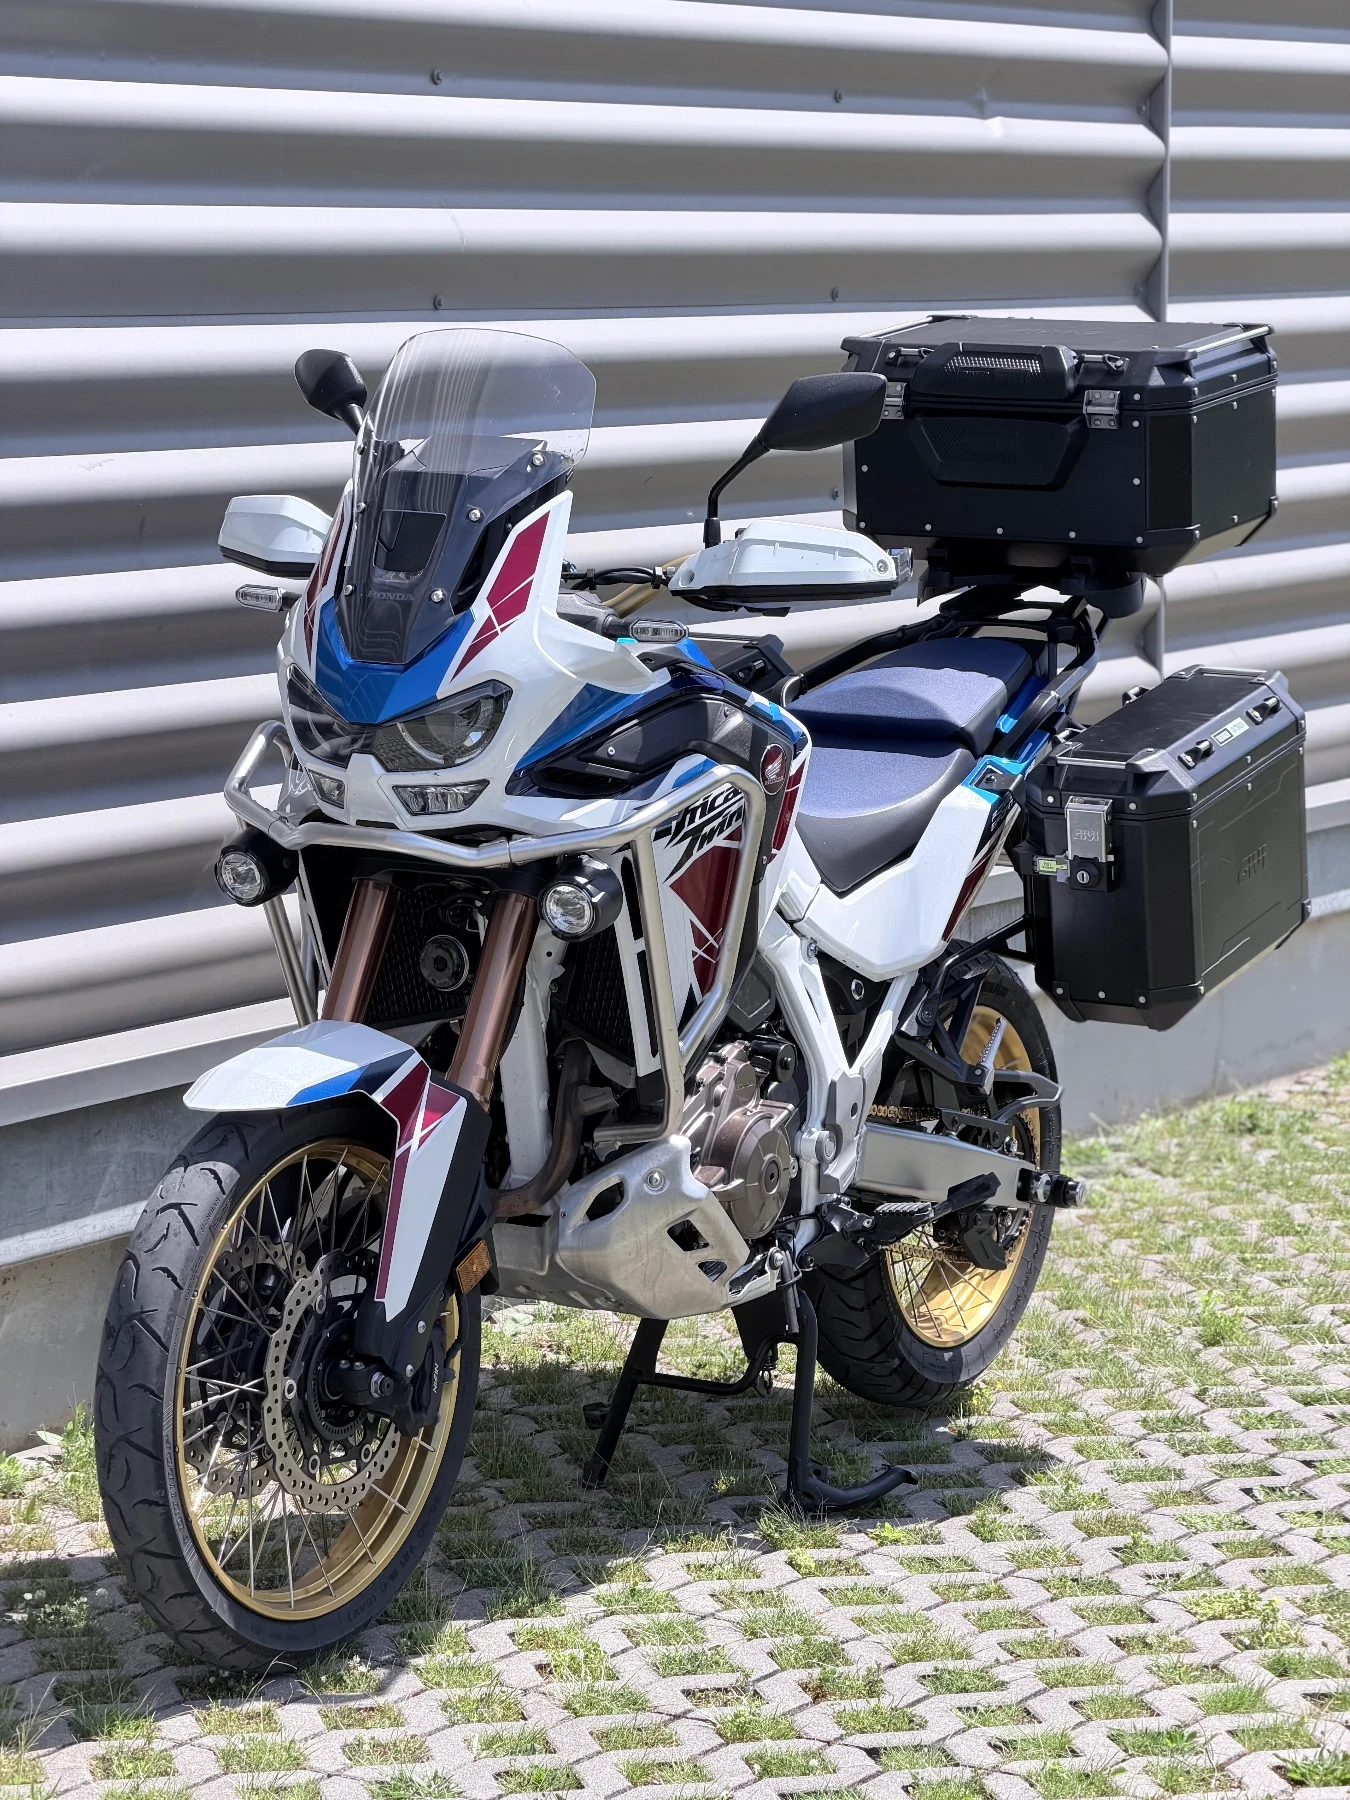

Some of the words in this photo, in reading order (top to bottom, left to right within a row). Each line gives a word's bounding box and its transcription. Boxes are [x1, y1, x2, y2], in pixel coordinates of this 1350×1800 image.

[368, 590, 415, 601] HONDA
[661, 796, 745, 885] Twin
[1071, 829, 1100, 842] GIVI
